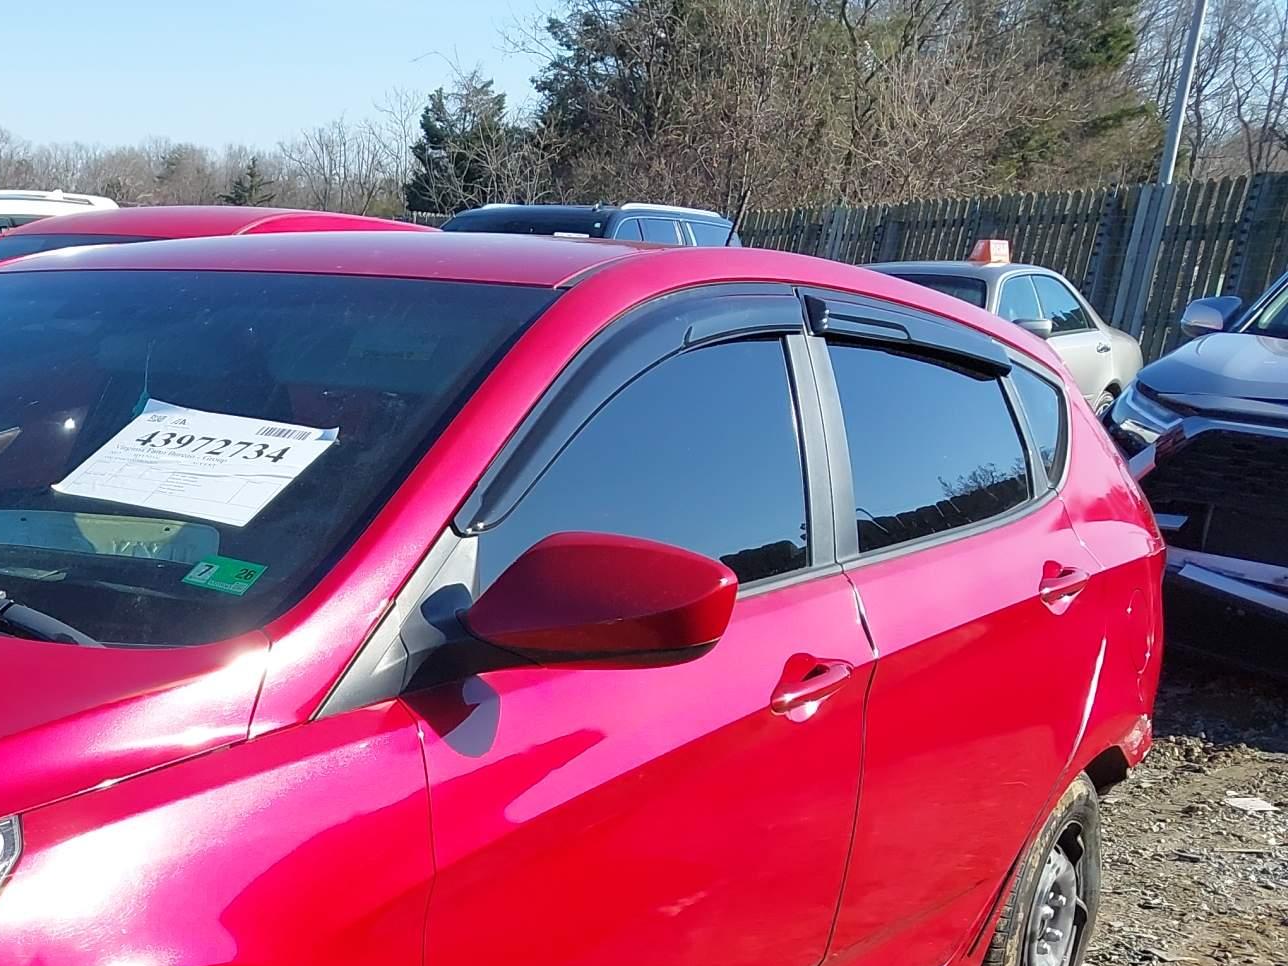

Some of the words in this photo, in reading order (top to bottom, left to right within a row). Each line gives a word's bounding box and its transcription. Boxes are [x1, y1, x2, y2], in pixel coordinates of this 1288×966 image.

[135, 430, 291, 463] 43972734
[198, 564, 214, 577] 7
[235, 568, 257, 581] 26
